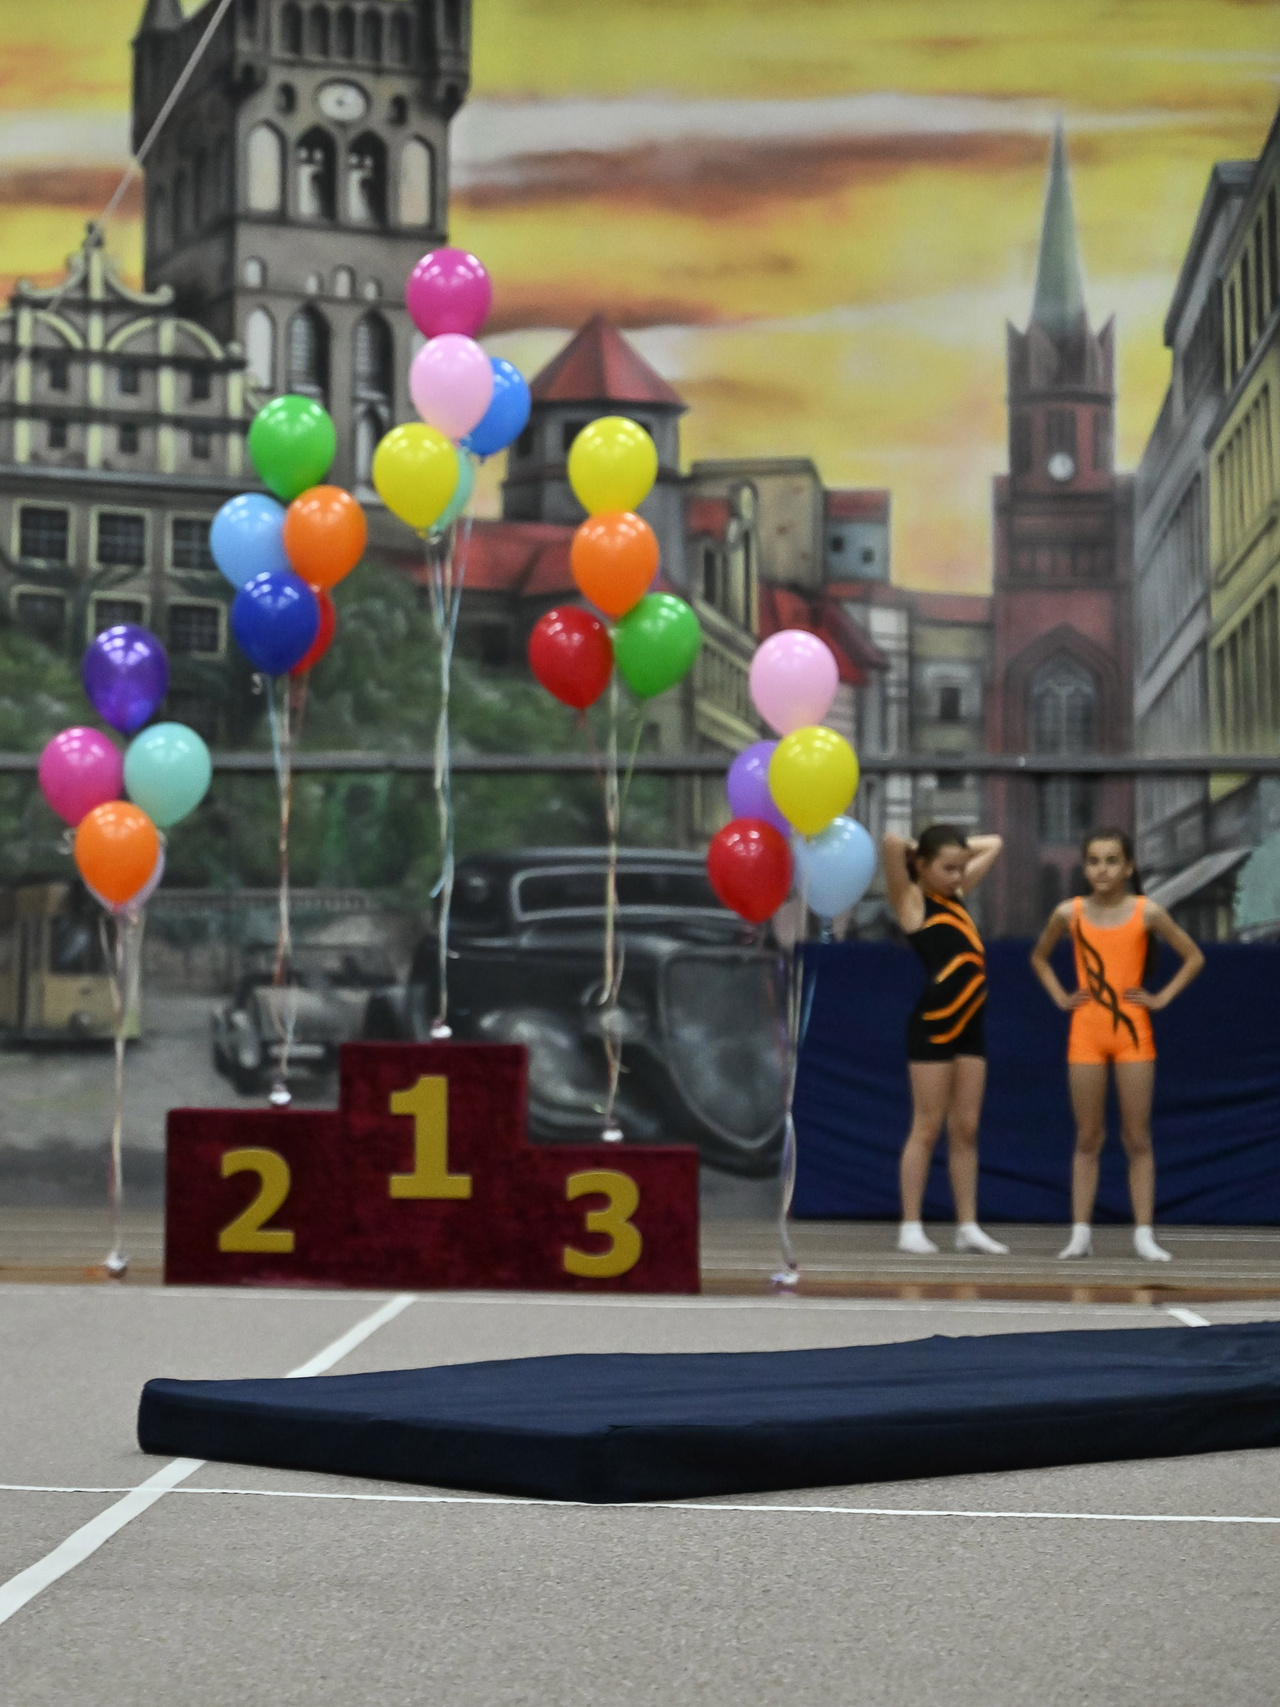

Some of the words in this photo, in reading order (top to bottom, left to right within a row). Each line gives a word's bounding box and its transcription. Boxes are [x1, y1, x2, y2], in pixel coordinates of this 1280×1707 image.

[389, 1074, 472, 1199] 1
[218, 1147, 295, 1253] 2
[563, 1170, 642, 1278] 3
